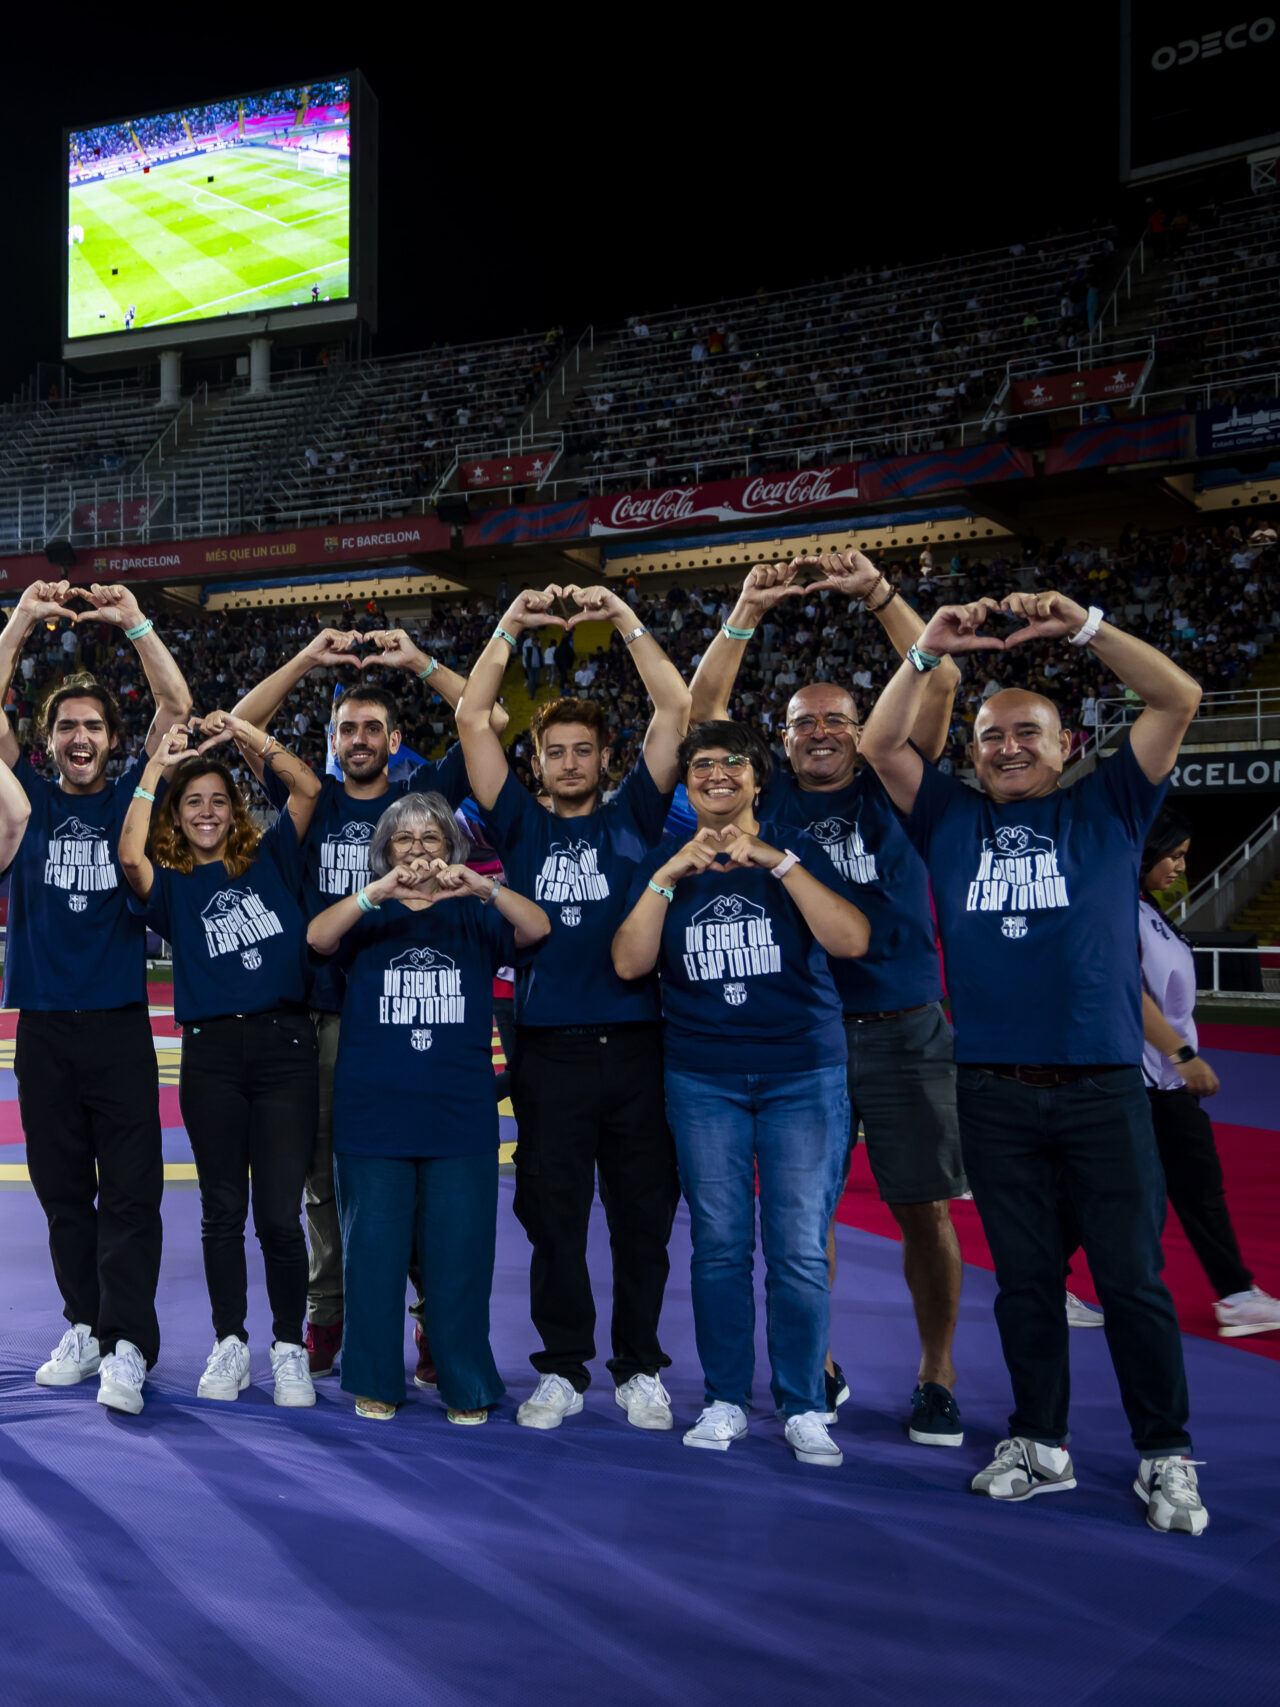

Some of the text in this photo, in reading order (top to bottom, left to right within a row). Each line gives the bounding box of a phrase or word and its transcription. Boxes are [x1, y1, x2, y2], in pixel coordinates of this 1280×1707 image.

[1151, 16, 1277, 71] ODECO
[205, 543, 297, 563] MÉS QUE UN CLUB
[341, 530, 420, 549] FC BARCELONA
[109, 554, 181, 571] FC BARCELONA
[48, 840, 62, 865] UN
[62, 840, 93, 866] SIGNE
[320, 842, 370, 870] UN SIGNE
[53, 865, 76, 890] SAP
[77, 863, 118, 891] TOTHOM
[327, 869, 350, 895] SAP
[543, 881, 570, 902] SAP
[966, 876, 1070, 911] EL SAP TOTHOM
[215, 904, 249, 933] SIGNE
[215, 932, 240, 954] SAP
[237, 910, 284, 947] TOTHOM
[685, 918, 774, 953] UN SIGNE QUE
[683, 945, 782, 981] EL SAP TOTHOM
[383, 969, 462, 999] UN SIGNE QUE
[379, 995, 466, 1024] EL SAP TOTHOM
